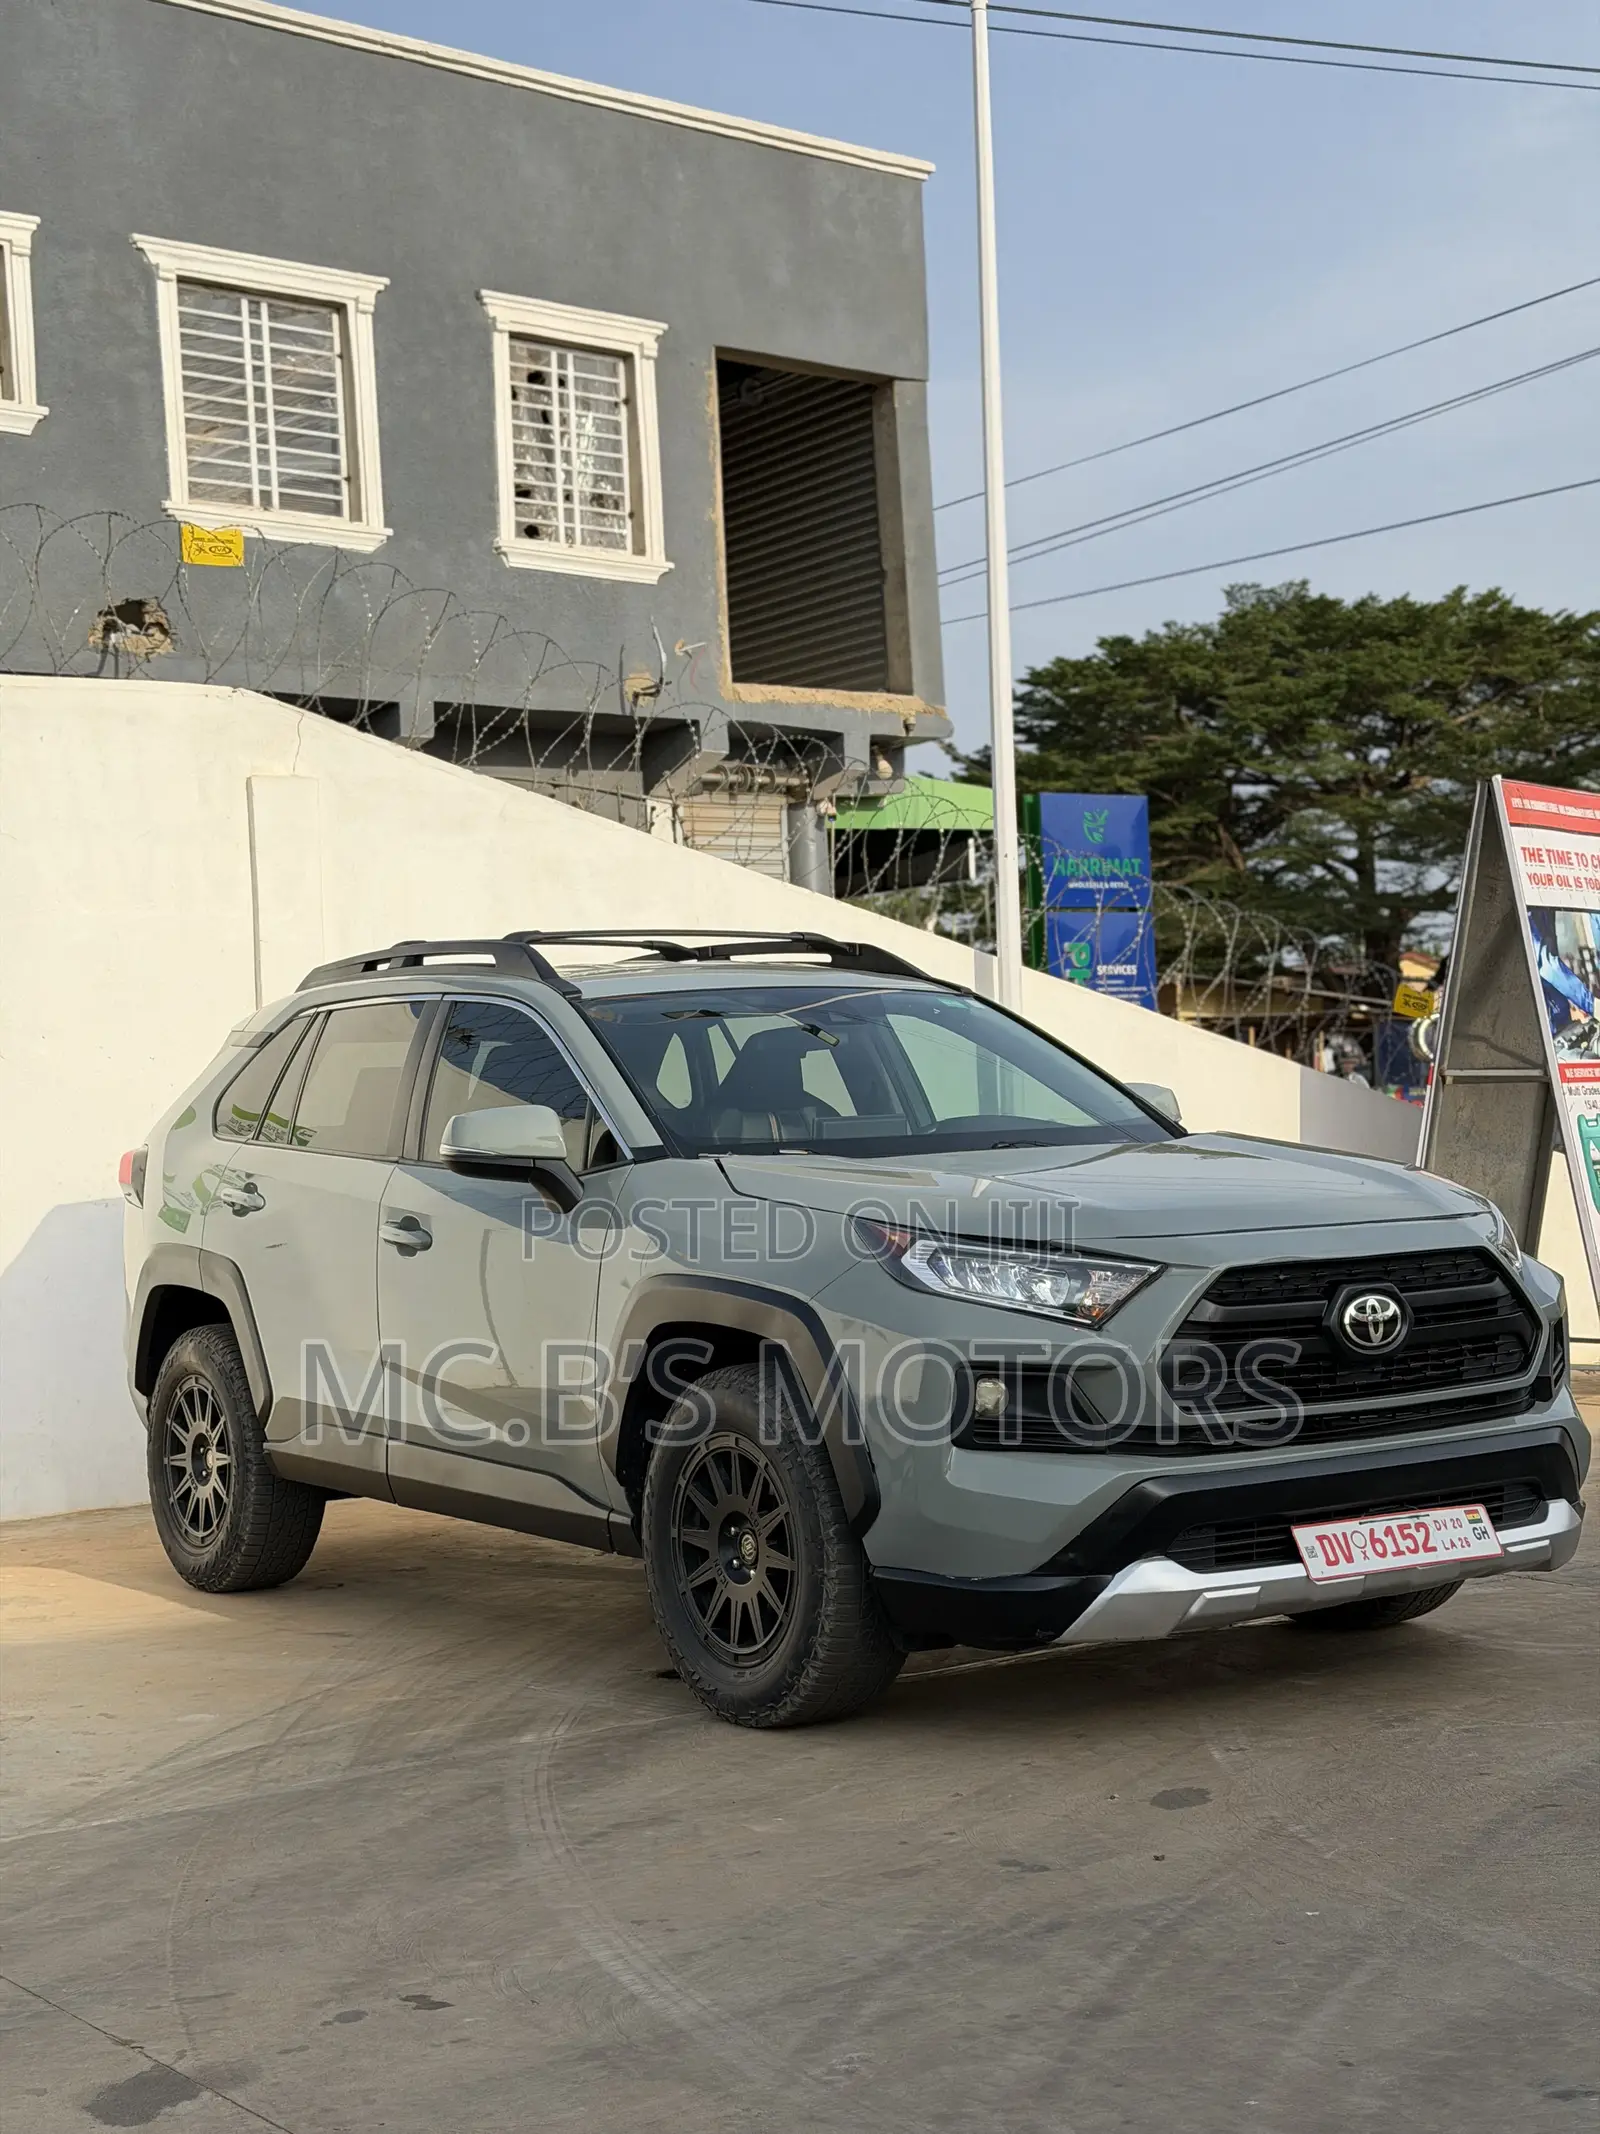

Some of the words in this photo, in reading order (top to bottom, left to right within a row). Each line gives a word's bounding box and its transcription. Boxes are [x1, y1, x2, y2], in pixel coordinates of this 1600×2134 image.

[1521, 846, 1545, 864] THE
[1545, 848, 1574, 867] TIME
[1575, 852, 1589, 869] TO
[1526, 871, 1554, 887] YOUR
[1556, 874, 1572, 889] OIL
[1573, 876, 1584, 889] IS
[1097, 965, 1137, 976] SERVICES
[1433, 1519, 1448, 1531] DV
[1450, 1518, 1463, 1529] 20
[1472, 1526, 1491, 1541] GH
[1315, 1531, 1354, 1567] DV
[1369, 1521, 1438, 1559] 6152
[1441, 1539, 1457, 1551] LA
